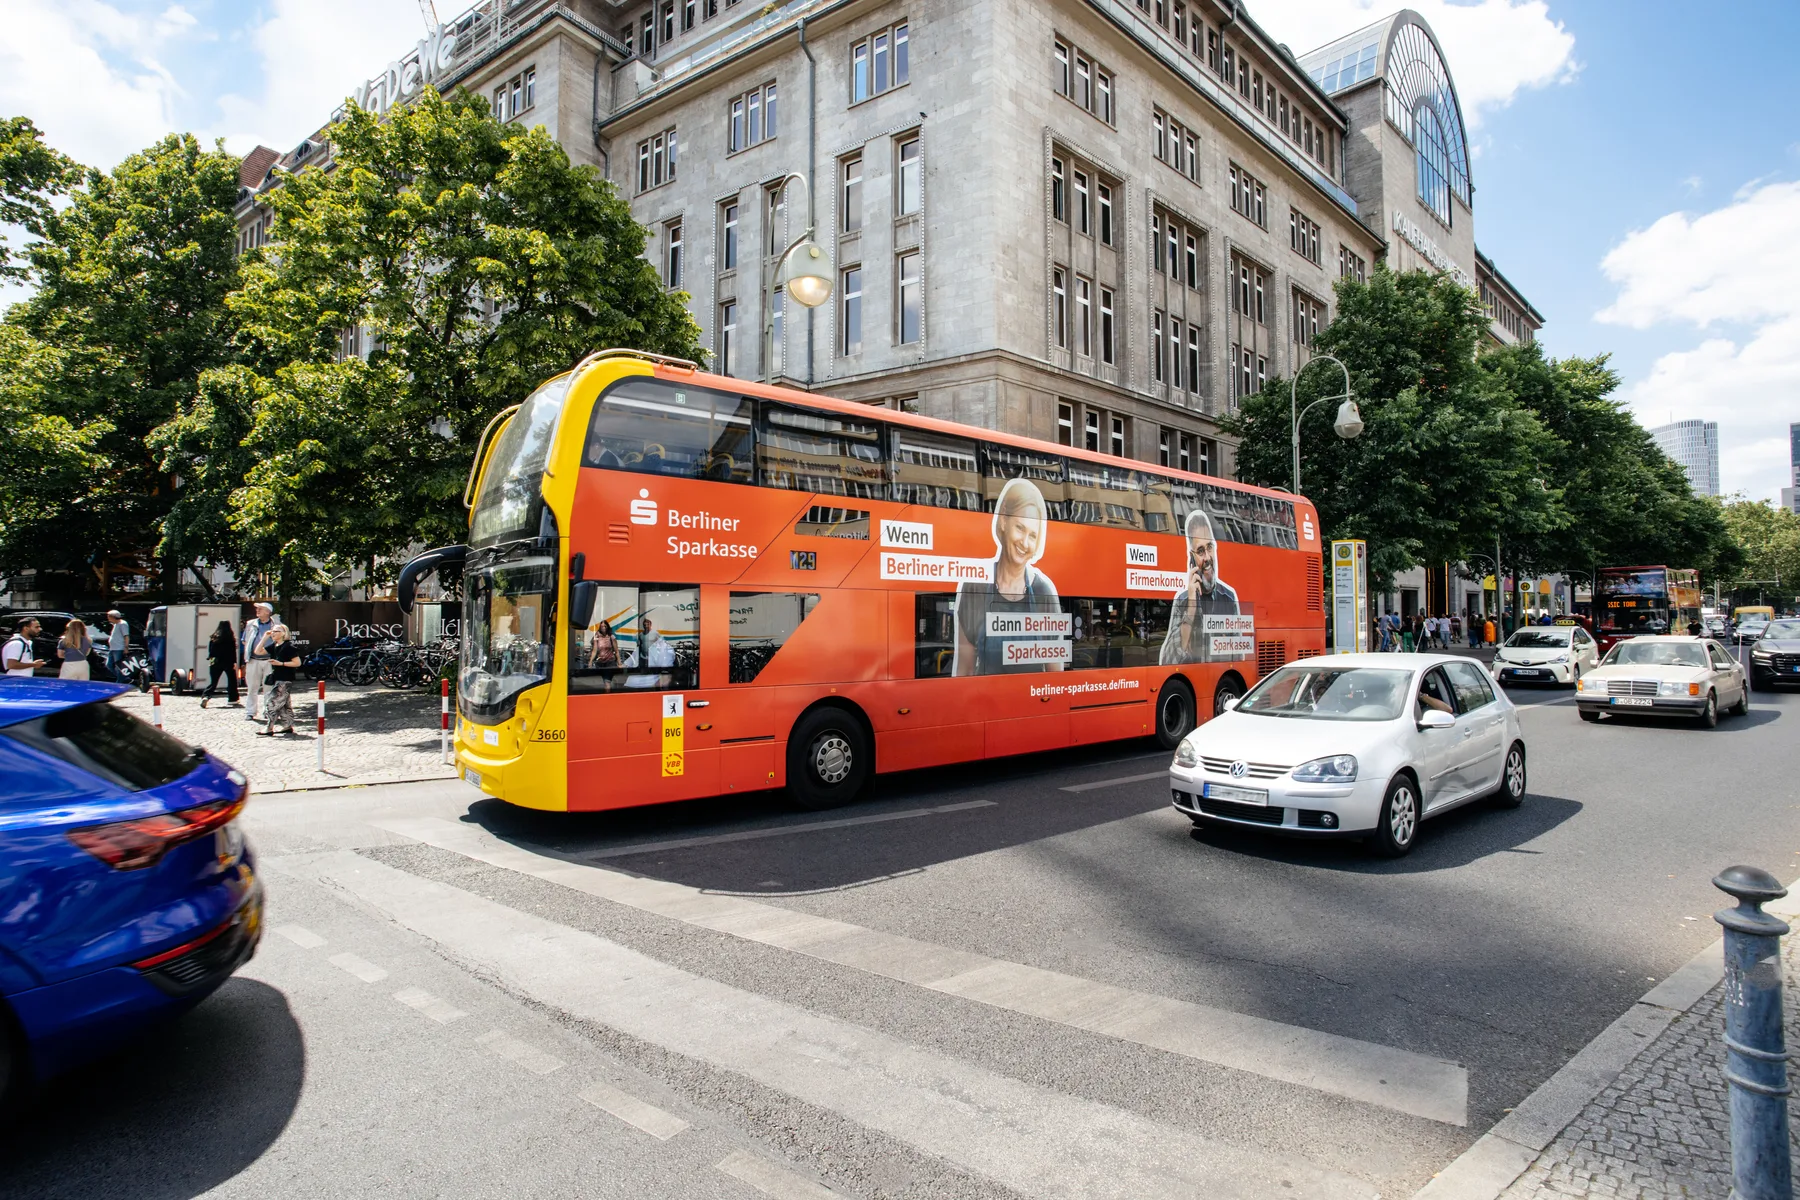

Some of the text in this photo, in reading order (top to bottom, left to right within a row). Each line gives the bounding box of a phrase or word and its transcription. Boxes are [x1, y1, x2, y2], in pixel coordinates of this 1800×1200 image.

[668, 509, 740, 531] Berliner
[886, 525, 929, 545] Wenn
[667, 536, 758, 558] Sparkasse
[1129, 547, 1155, 562] Wenn
[790, 551, 815, 570] M29
[887, 557, 989, 580] Berliner Firma,
[1130, 572, 1186, 589] Firmenkonto,
[992, 616, 1068, 632] dann Berliner
[1207, 617, 1252, 630] dann Berliner
[1008, 643, 1068, 662] Sparkasse.
[1213, 639, 1252, 652] Sparkasse.
[1030, 678, 1139, 697] berliner-sparkasse.de/firma
[537, 729, 566, 740] 3660
[665, 727, 681, 738] BVG
[666, 760, 681, 768] VBB
